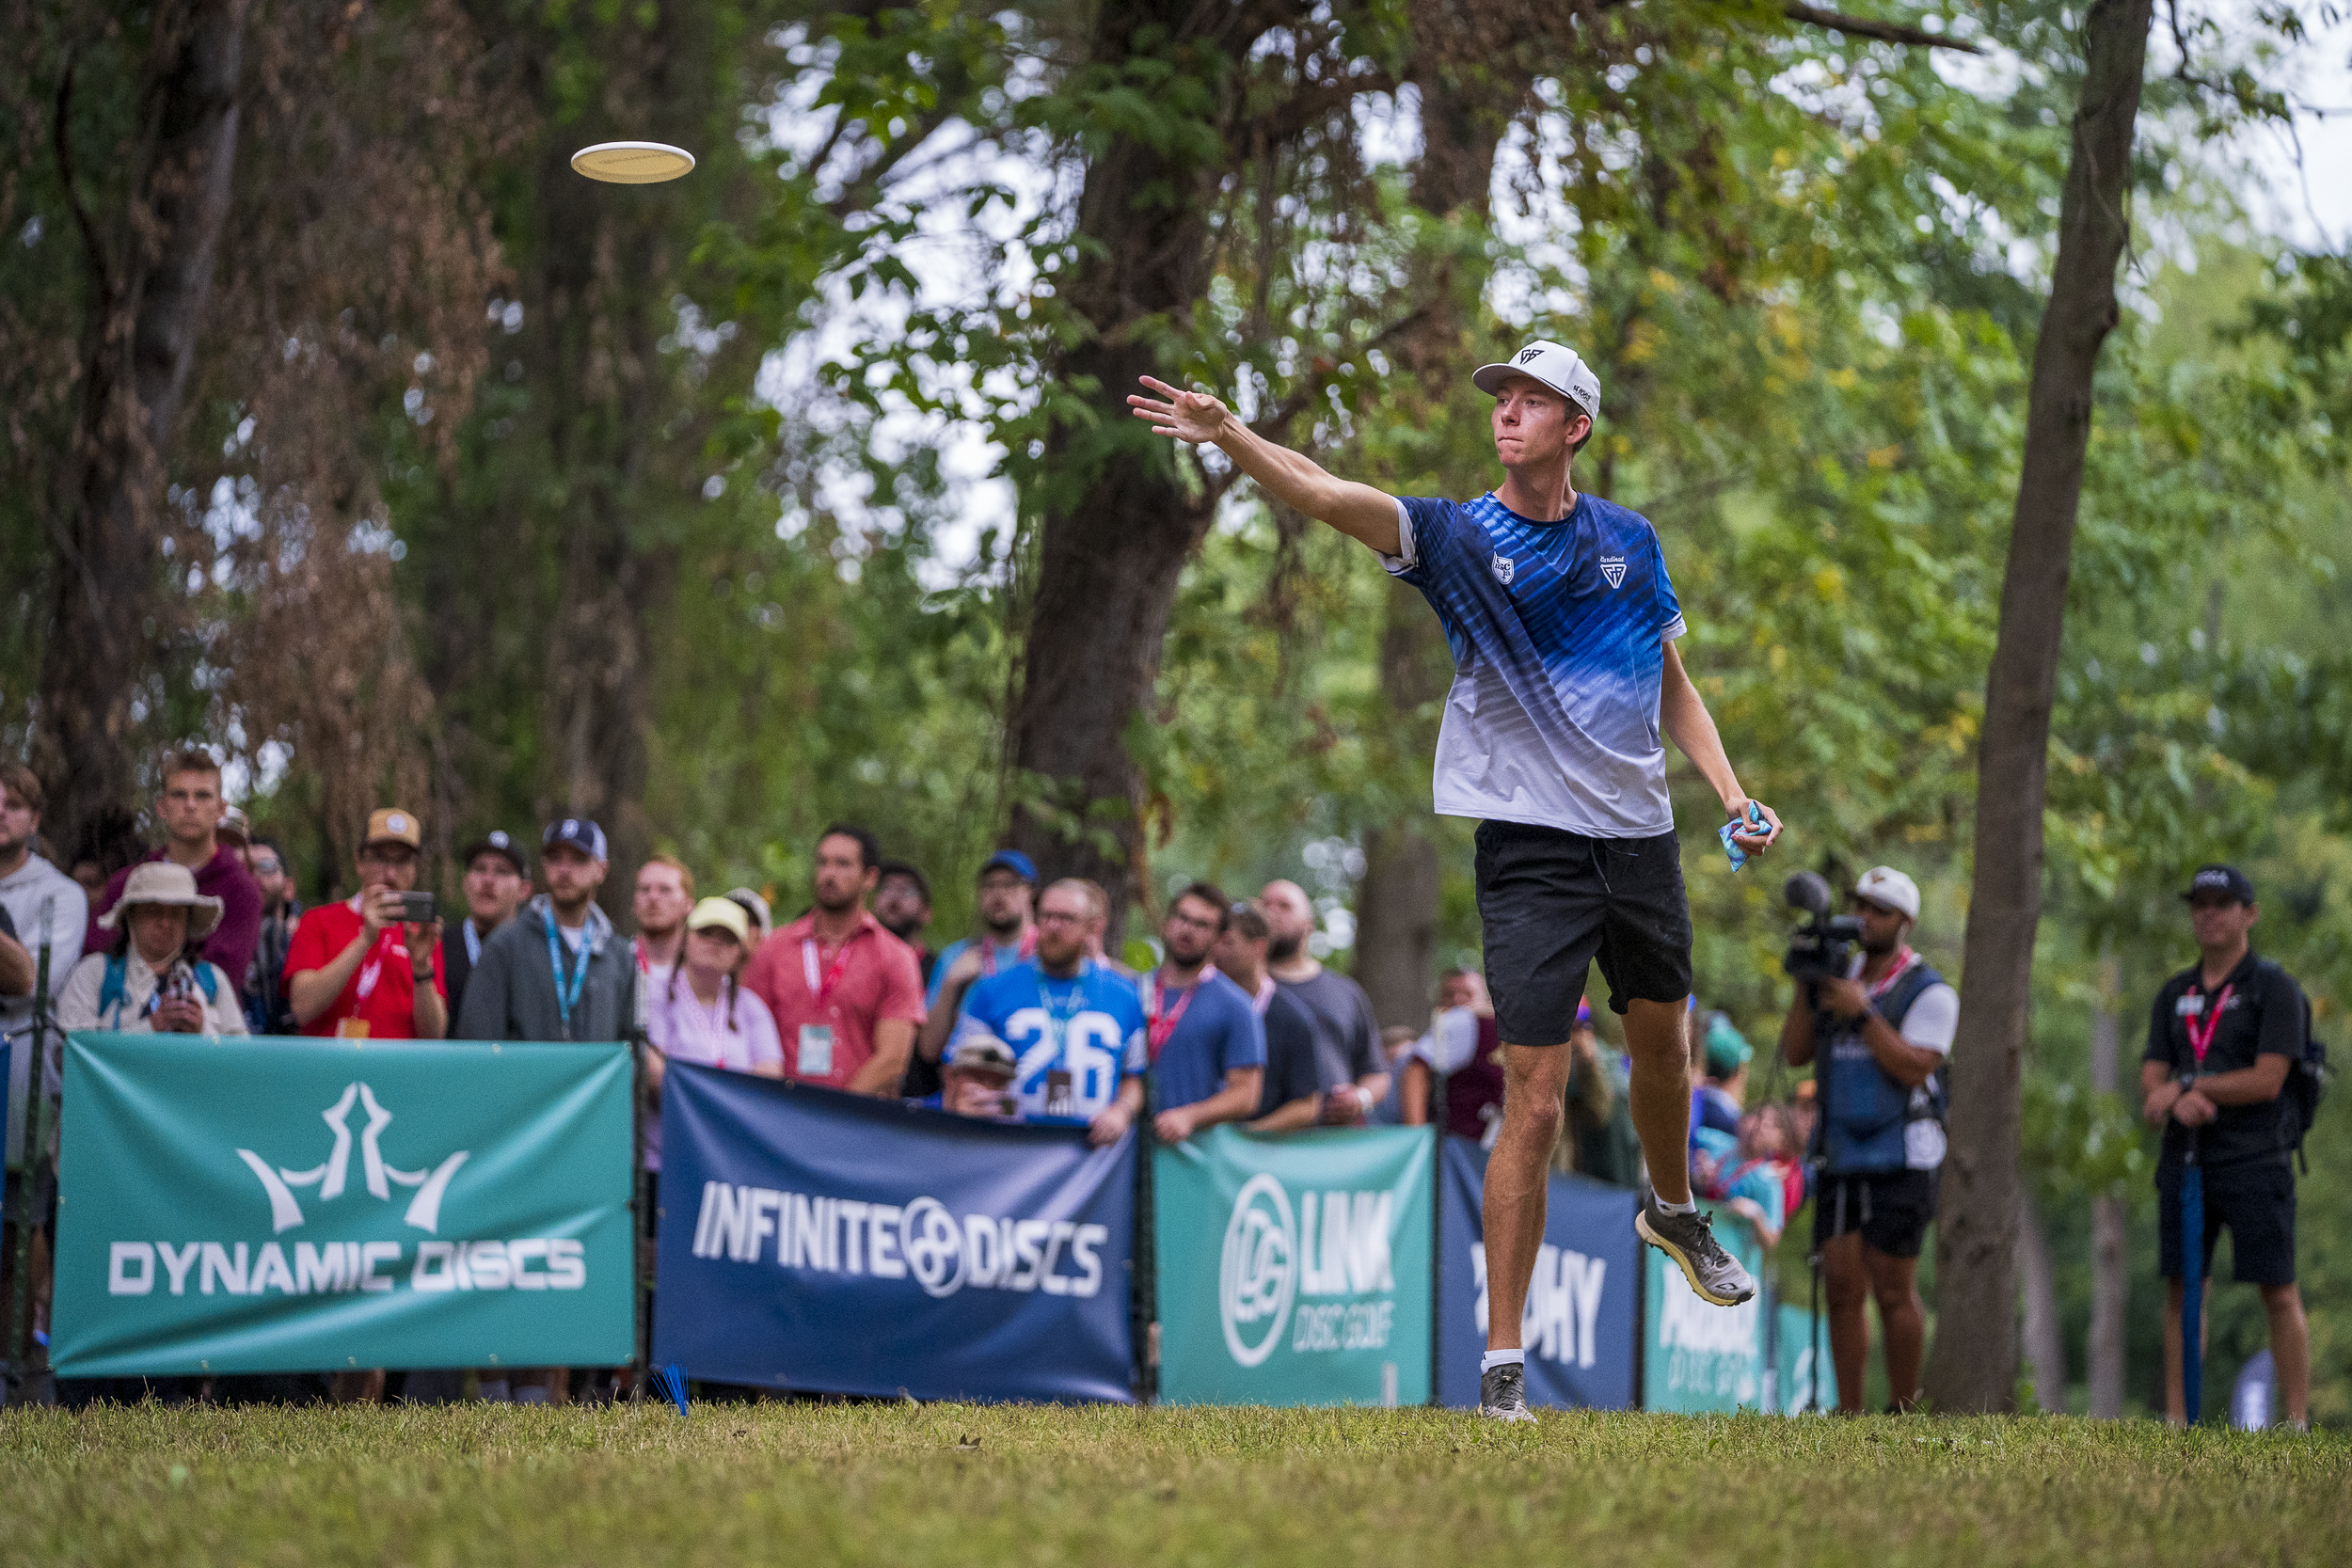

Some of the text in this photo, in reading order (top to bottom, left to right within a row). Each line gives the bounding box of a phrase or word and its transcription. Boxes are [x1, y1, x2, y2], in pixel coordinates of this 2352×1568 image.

[1005, 1006, 1122, 1117] 26
[108, 1237, 587, 1296] DYNAMIC DISCS
[691, 1180, 1108, 1298] INFINITE DISCS
[1300, 1189, 1396, 1296] LINK
